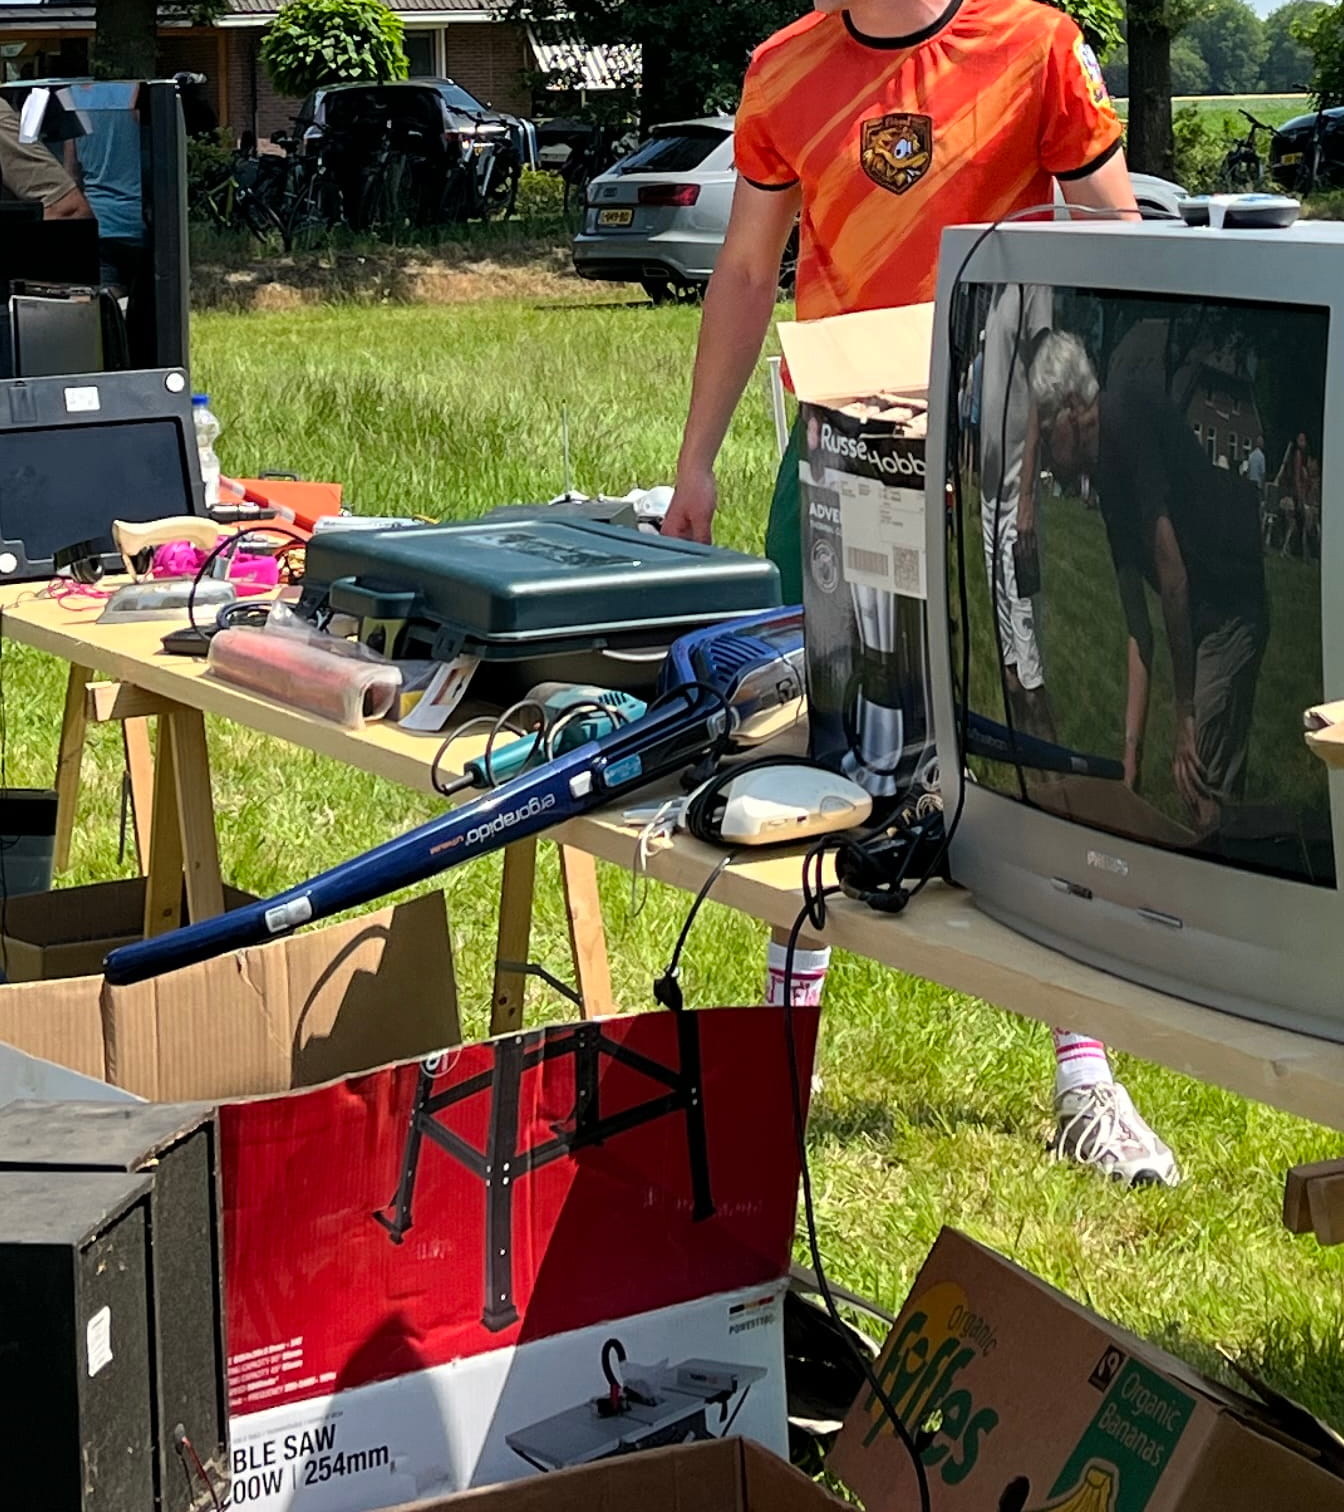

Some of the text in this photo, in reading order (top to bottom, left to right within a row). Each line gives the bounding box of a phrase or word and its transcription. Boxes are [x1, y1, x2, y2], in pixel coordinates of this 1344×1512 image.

[820, 423, 867, 460] Russe
[867, 449, 926, 476] Hobb
[809, 502, 840, 523] ADVE
[465, 793, 556, 846] ergorapido
[947, 1303, 999, 1359] Organic
[862, 1310, 1000, 1486] fyffes
[1119, 1371, 1183, 1434] Organic
[232, 1441, 275, 1475] BLE
[283, 1423, 337, 1461] SAW
[1097, 1400, 1166, 1468] Bananas
[232, 1445, 389, 1505] 00W 254mm
